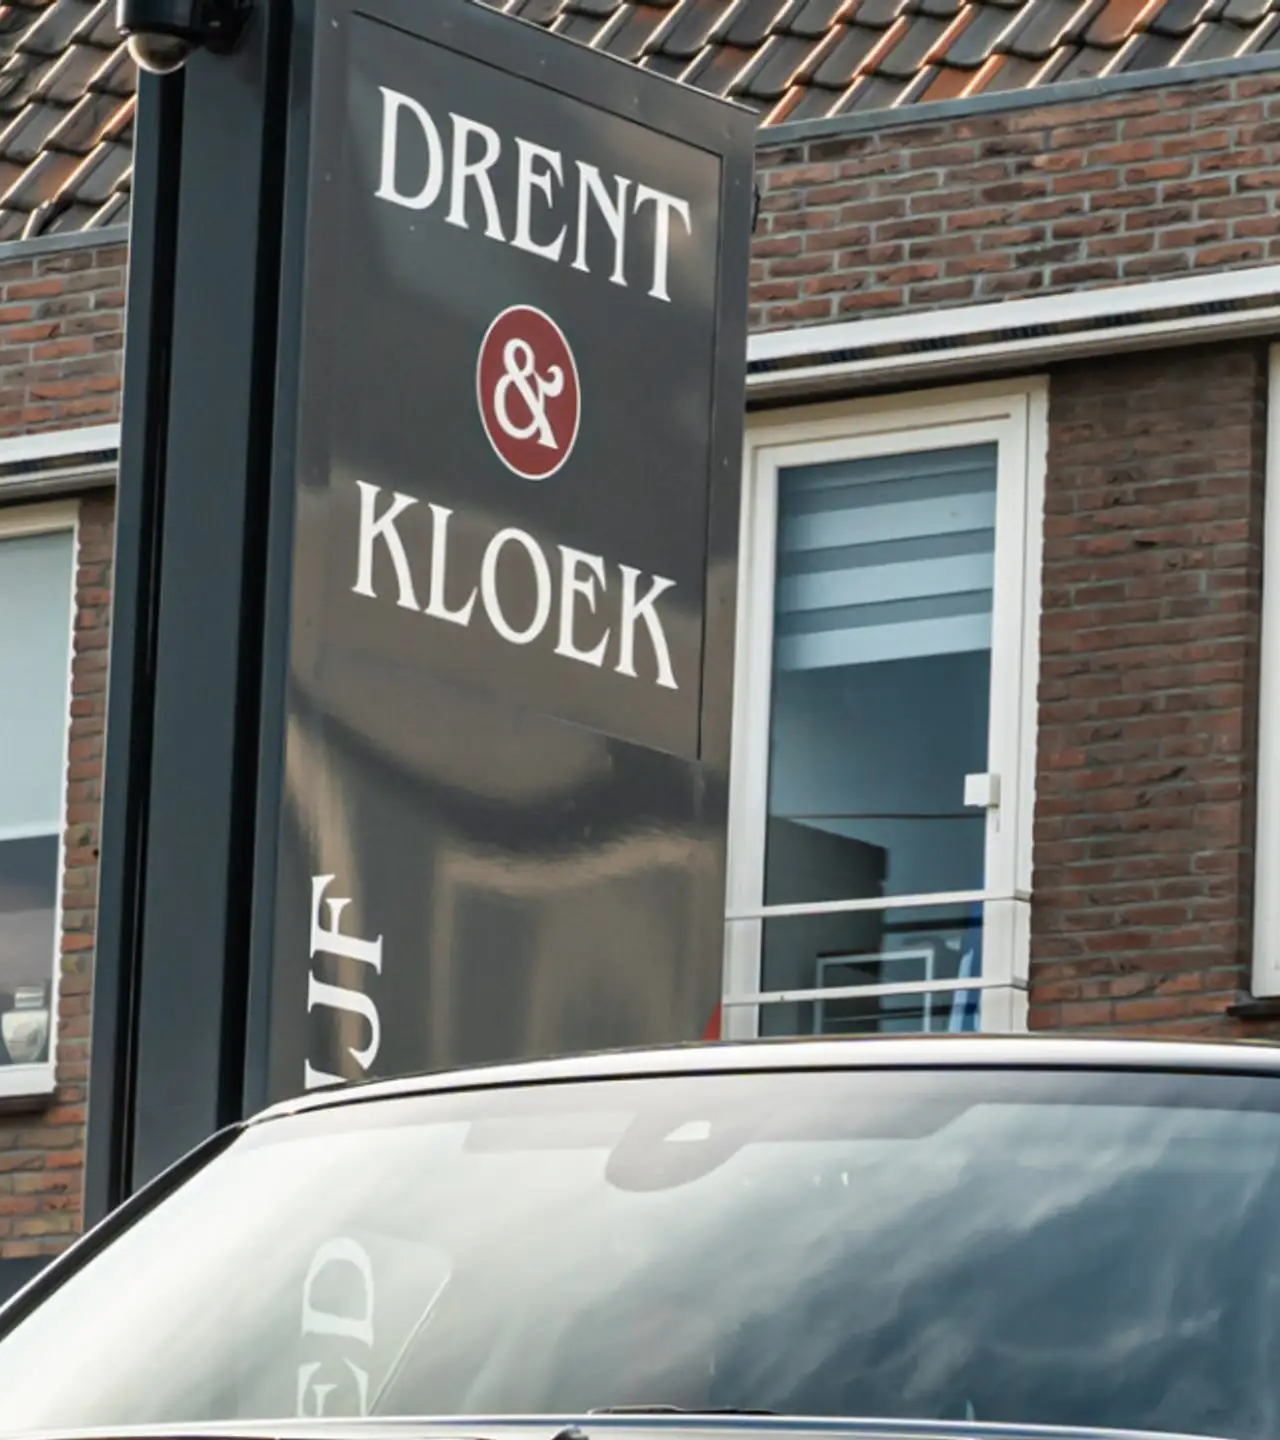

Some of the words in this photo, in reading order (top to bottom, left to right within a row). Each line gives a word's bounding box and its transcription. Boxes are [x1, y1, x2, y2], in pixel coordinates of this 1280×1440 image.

[375, 86, 691, 302] DRENT
[493, 337, 564, 450] &
[351, 480, 678, 689] KLOEK
